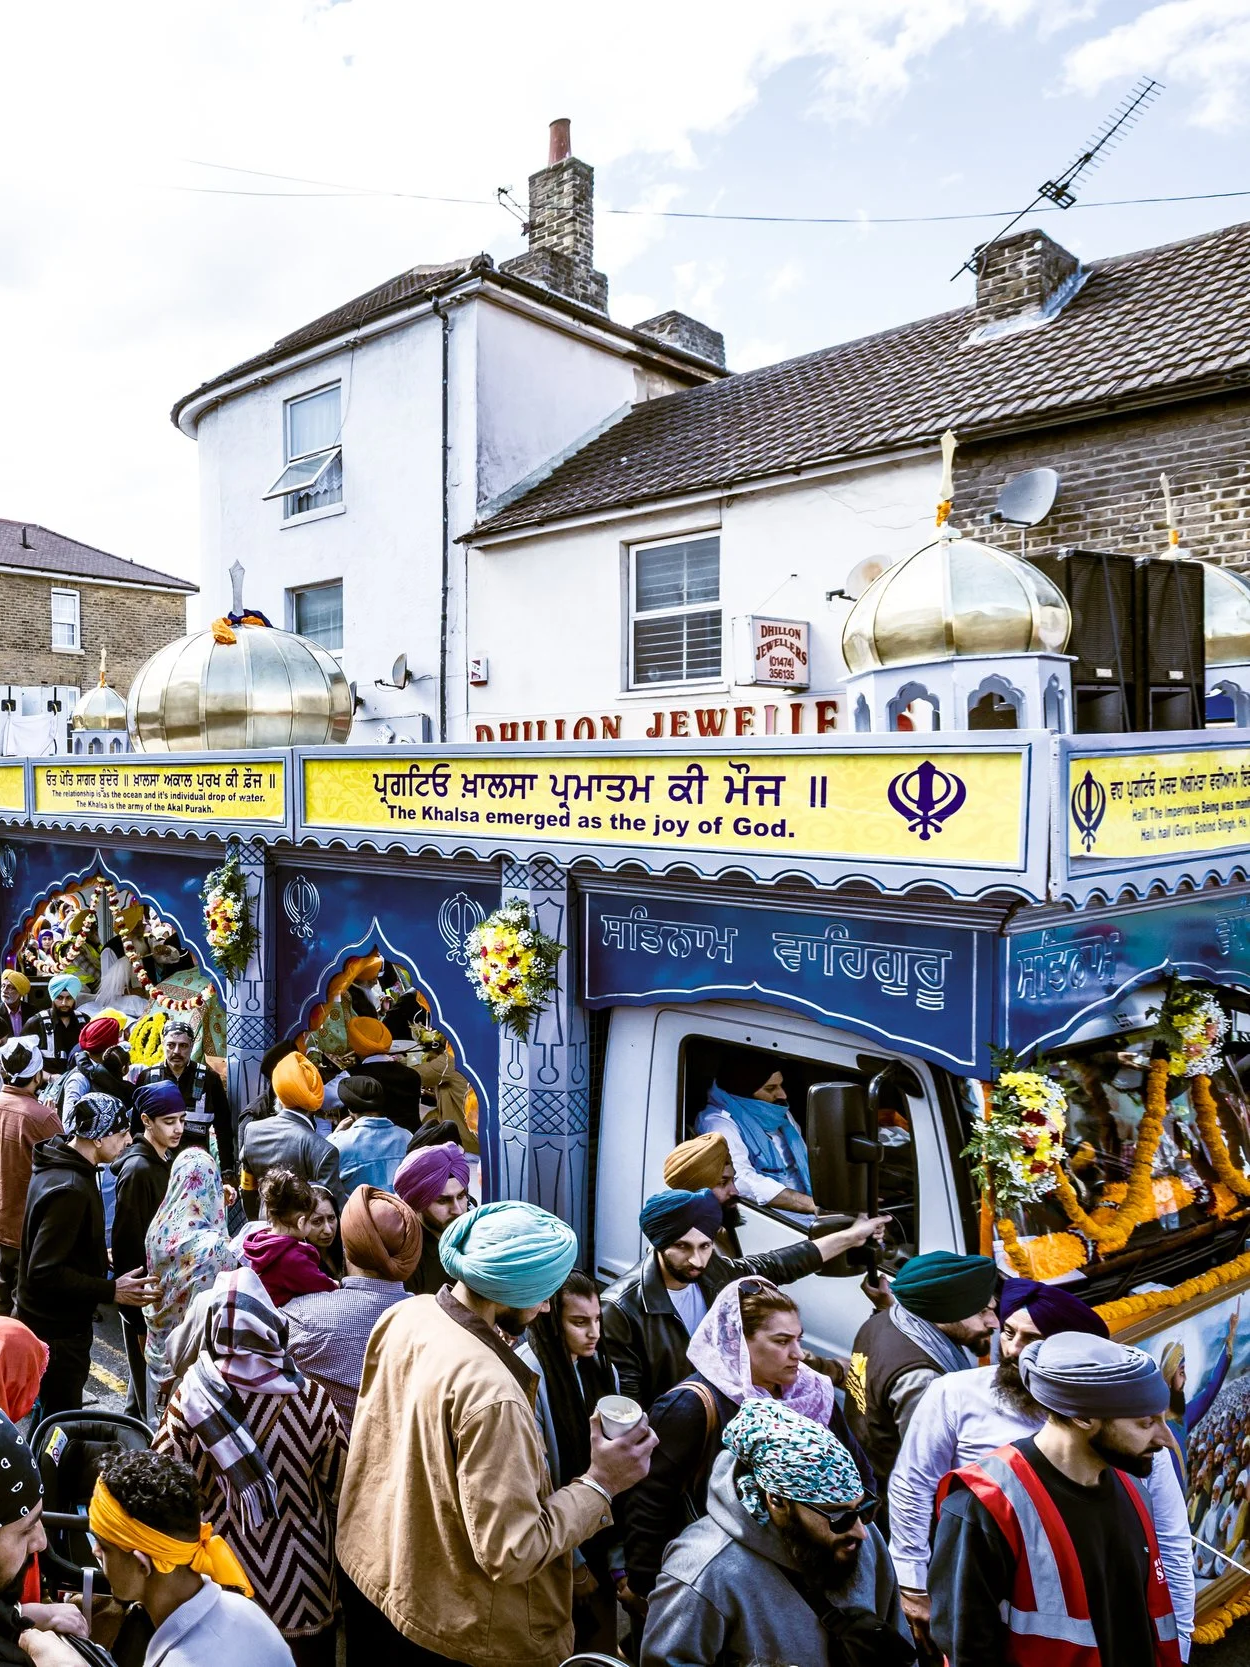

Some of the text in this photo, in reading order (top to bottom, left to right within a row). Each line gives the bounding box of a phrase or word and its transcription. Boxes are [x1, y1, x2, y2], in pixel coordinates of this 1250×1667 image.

[760, 624, 801, 641] DHILLON
[756, 638, 807, 666] JEWELLERS
[769, 655, 795, 669] (01474)
[769, 668, 795, 681] 356135
[76, 774, 96, 787] ਸਾਗਰ
[163, 774, 193, 788] ਅਕਾਲ
[225, 768, 239, 788] ਕੀ
[373, 763, 451, 803] ਪ੍ਰਗਟਿਓ
[461, 774, 538, 800] ਖ਼ਾਲਸਾ
[550, 774, 654, 808] ਪ੍ਰਮਾਤਮ
[668, 763, 709, 805] ਕੀ
[724, 761, 786, 807] ਮੌਜ
[63, 790, 95, 798] relationship
[157, 791, 169, 799] it's
[170, 792, 206, 801] individual
[208, 793, 226, 802] drop
[228, 793, 237, 801] of
[239, 794, 266, 802] water.
[88, 801, 108, 809] Khalsa
[128, 803, 144, 812] army
[145, 803, 152, 811] of
[154, 803, 165, 811] the
[167, 803, 184, 812] Akal
[185, 804, 214, 813] Purakh.
[1149, 806, 1163, 819] The
[1201, 801, 1220, 815] Being
[1221, 801, 1234, 812] was
[387, 805, 796, 838] The Khalsa emerged as the joy of God.
[601, 905, 952, 1010] ਸਤਿਨਾਮ ਵਾਹਿਗੁਰੂ
